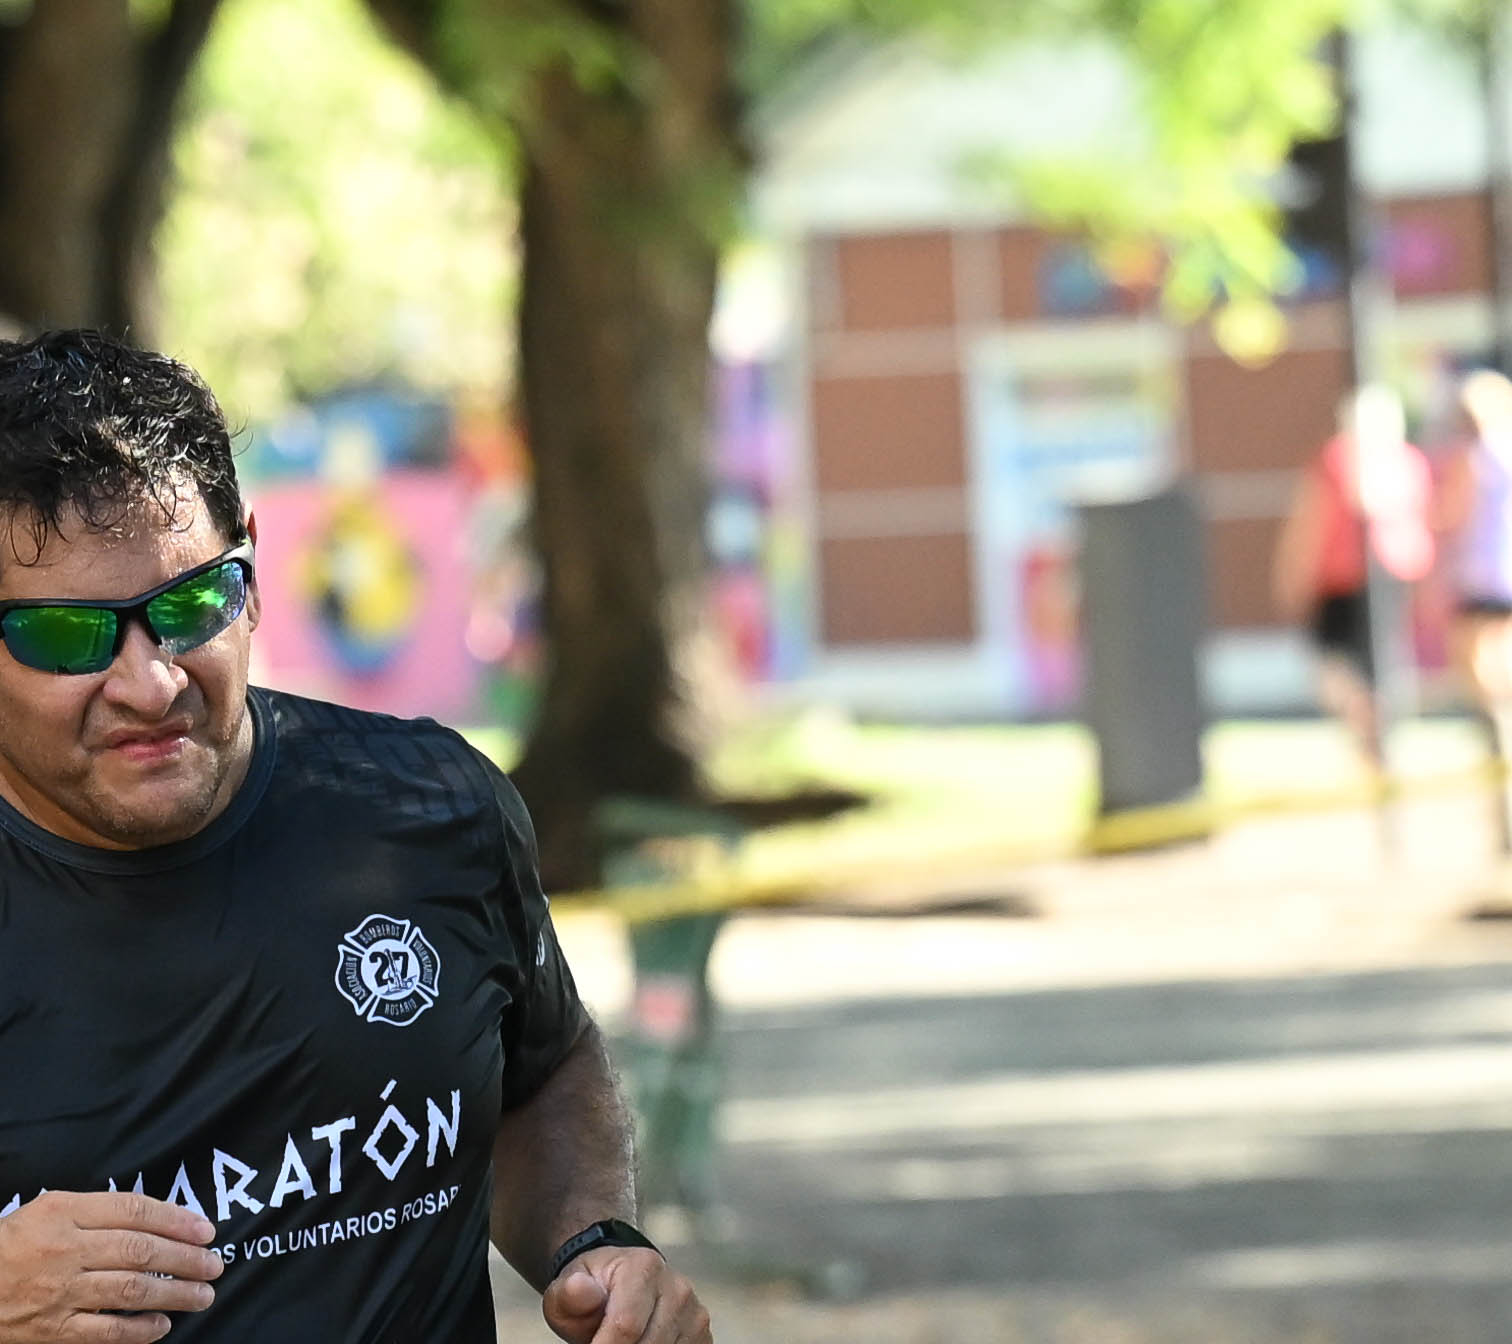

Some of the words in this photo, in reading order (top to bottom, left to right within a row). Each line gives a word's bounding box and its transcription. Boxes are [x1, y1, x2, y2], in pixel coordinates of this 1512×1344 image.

[368, 950, 410, 988] 27
[384, 997, 417, 1016] ROSARIO
[108, 1078, 462, 1223] ARATÓN
[243, 1207, 397, 1261] VOLUNTARIOS
